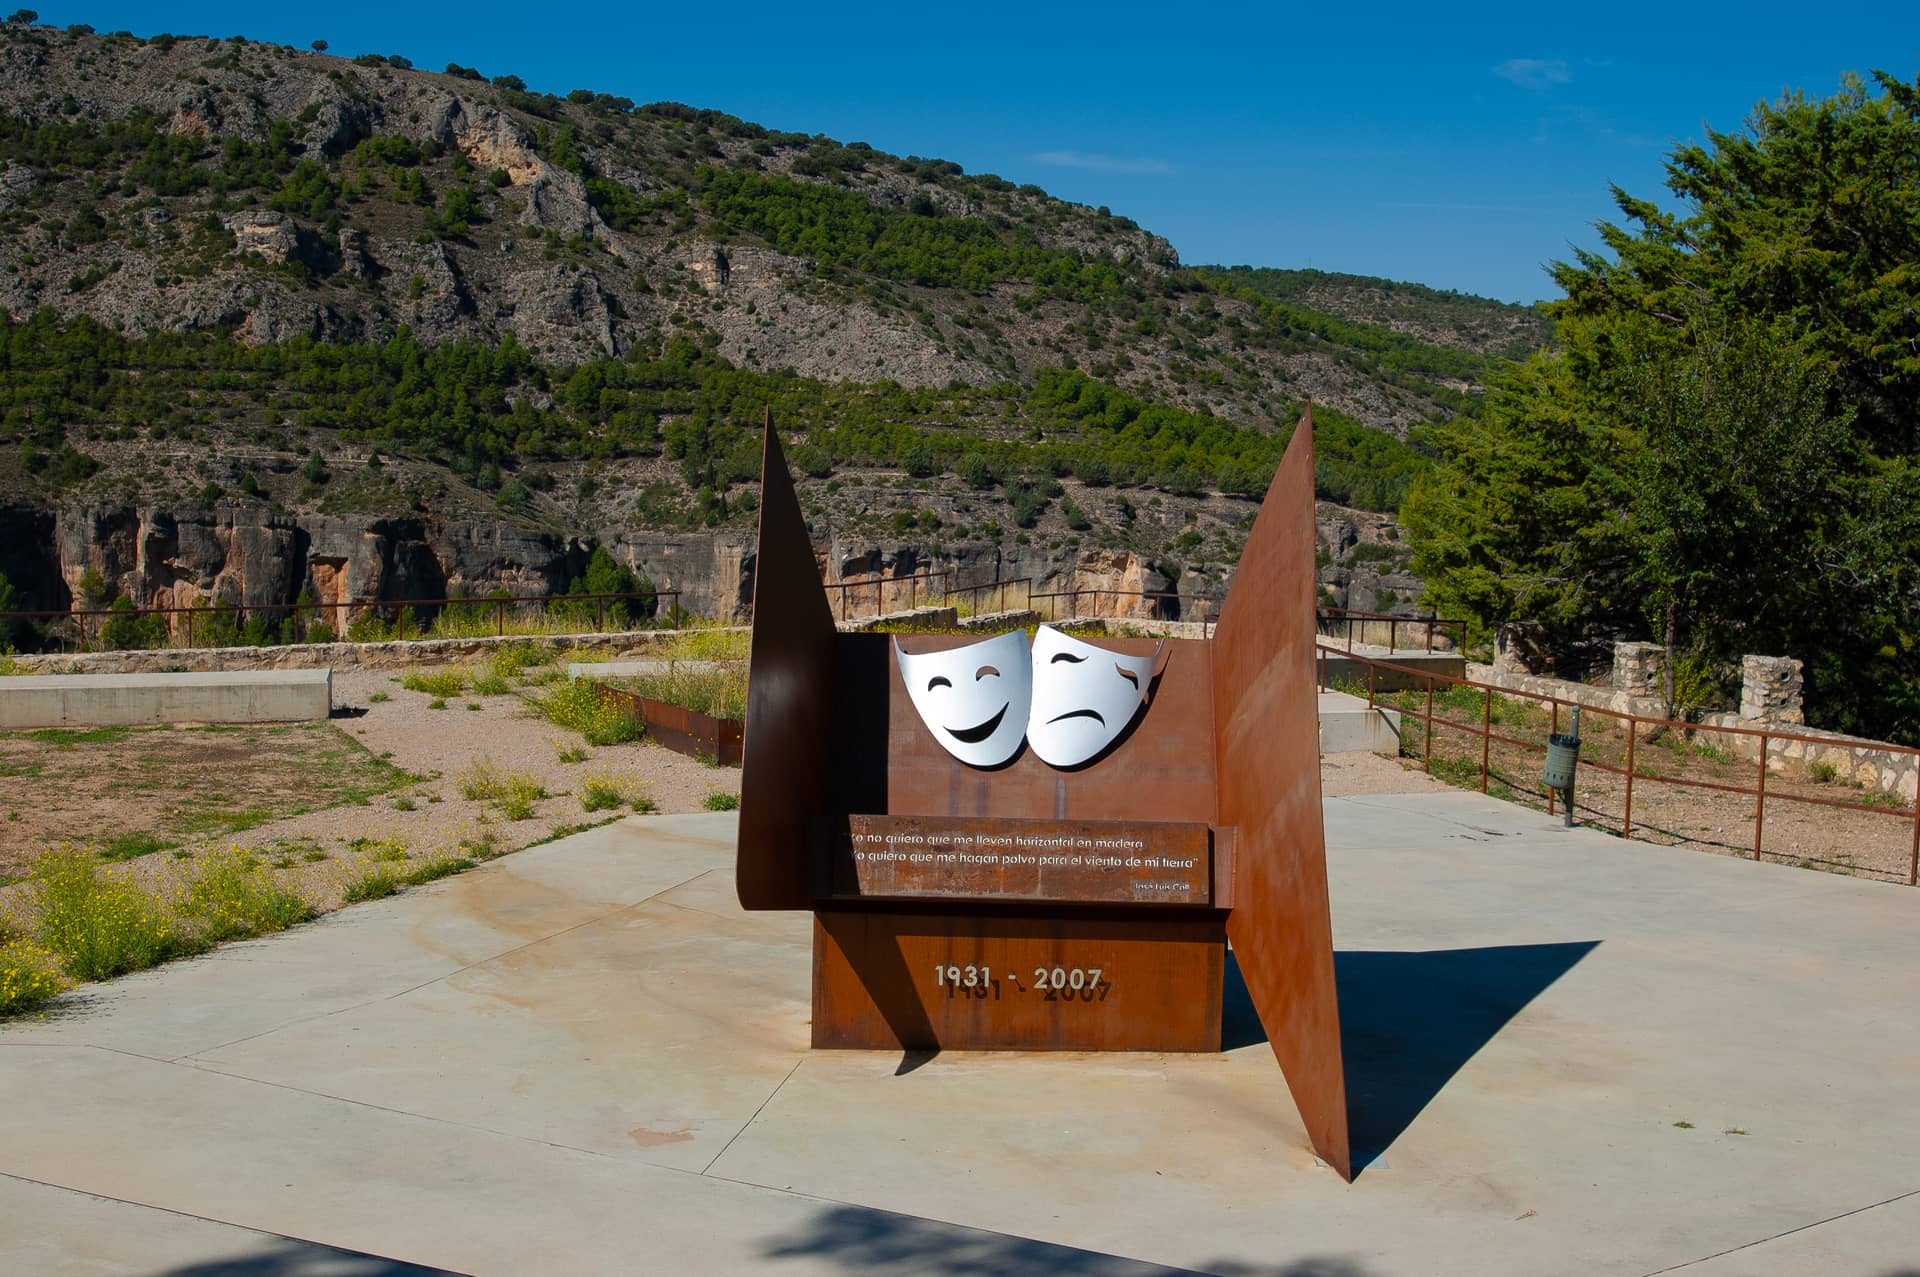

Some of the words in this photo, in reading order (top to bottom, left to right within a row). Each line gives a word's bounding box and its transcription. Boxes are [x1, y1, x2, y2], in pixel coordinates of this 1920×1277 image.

[867, 833, 882, 843] no
[886, 832, 924, 845] quiero
[927, 835, 950, 846] que
[953, 836, 973, 844] me
[976, 835, 1012, 845] lleven
[1016, 836, 1073, 847] horizontal
[1077, 839, 1092, 848] en
[1095, 839, 1143, 849] madera
[868, 851, 906, 863] quiero
[909, 854, 933, 864] que
[936, 854, 956, 863] me
[959, 852, 999, 865] hagan
[1002, 854, 1036, 866] polvo
[1039, 857, 1067, 867] para
[1071, 855, 1082, 865] el
[1085, 855, 1122, 867] viento
[1125, 856, 1141, 868] de
[1144, 857, 1159, 868] mi
[935, 965, 990, 988] 1931
[1033, 967, 1102, 990] 2007
